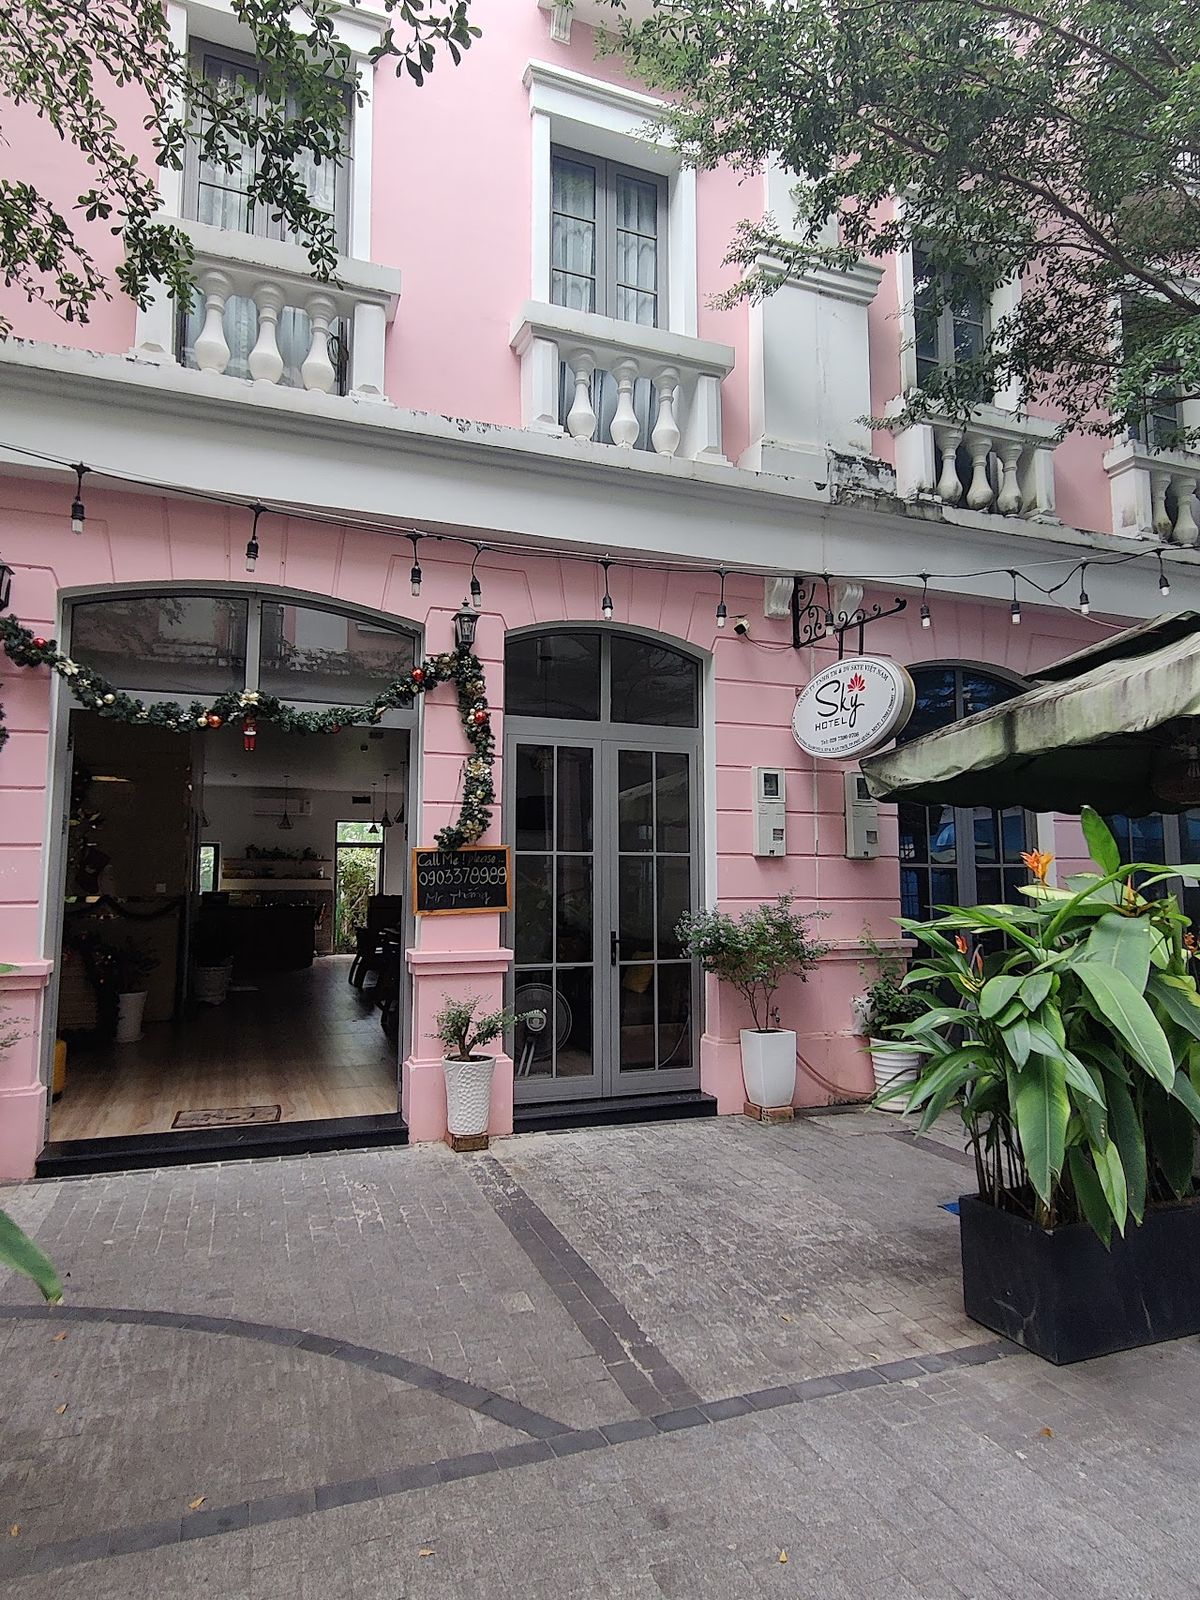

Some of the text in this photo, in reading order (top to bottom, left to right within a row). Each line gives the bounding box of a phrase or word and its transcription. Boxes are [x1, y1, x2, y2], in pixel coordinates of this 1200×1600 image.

[876, 669, 889, 682] NAM
[815, 679, 866, 728] Sky
[814, 717, 848, 732] HOTEL
[417, 853, 441, 867] Call
[418, 866, 507, 886] 0903378989
